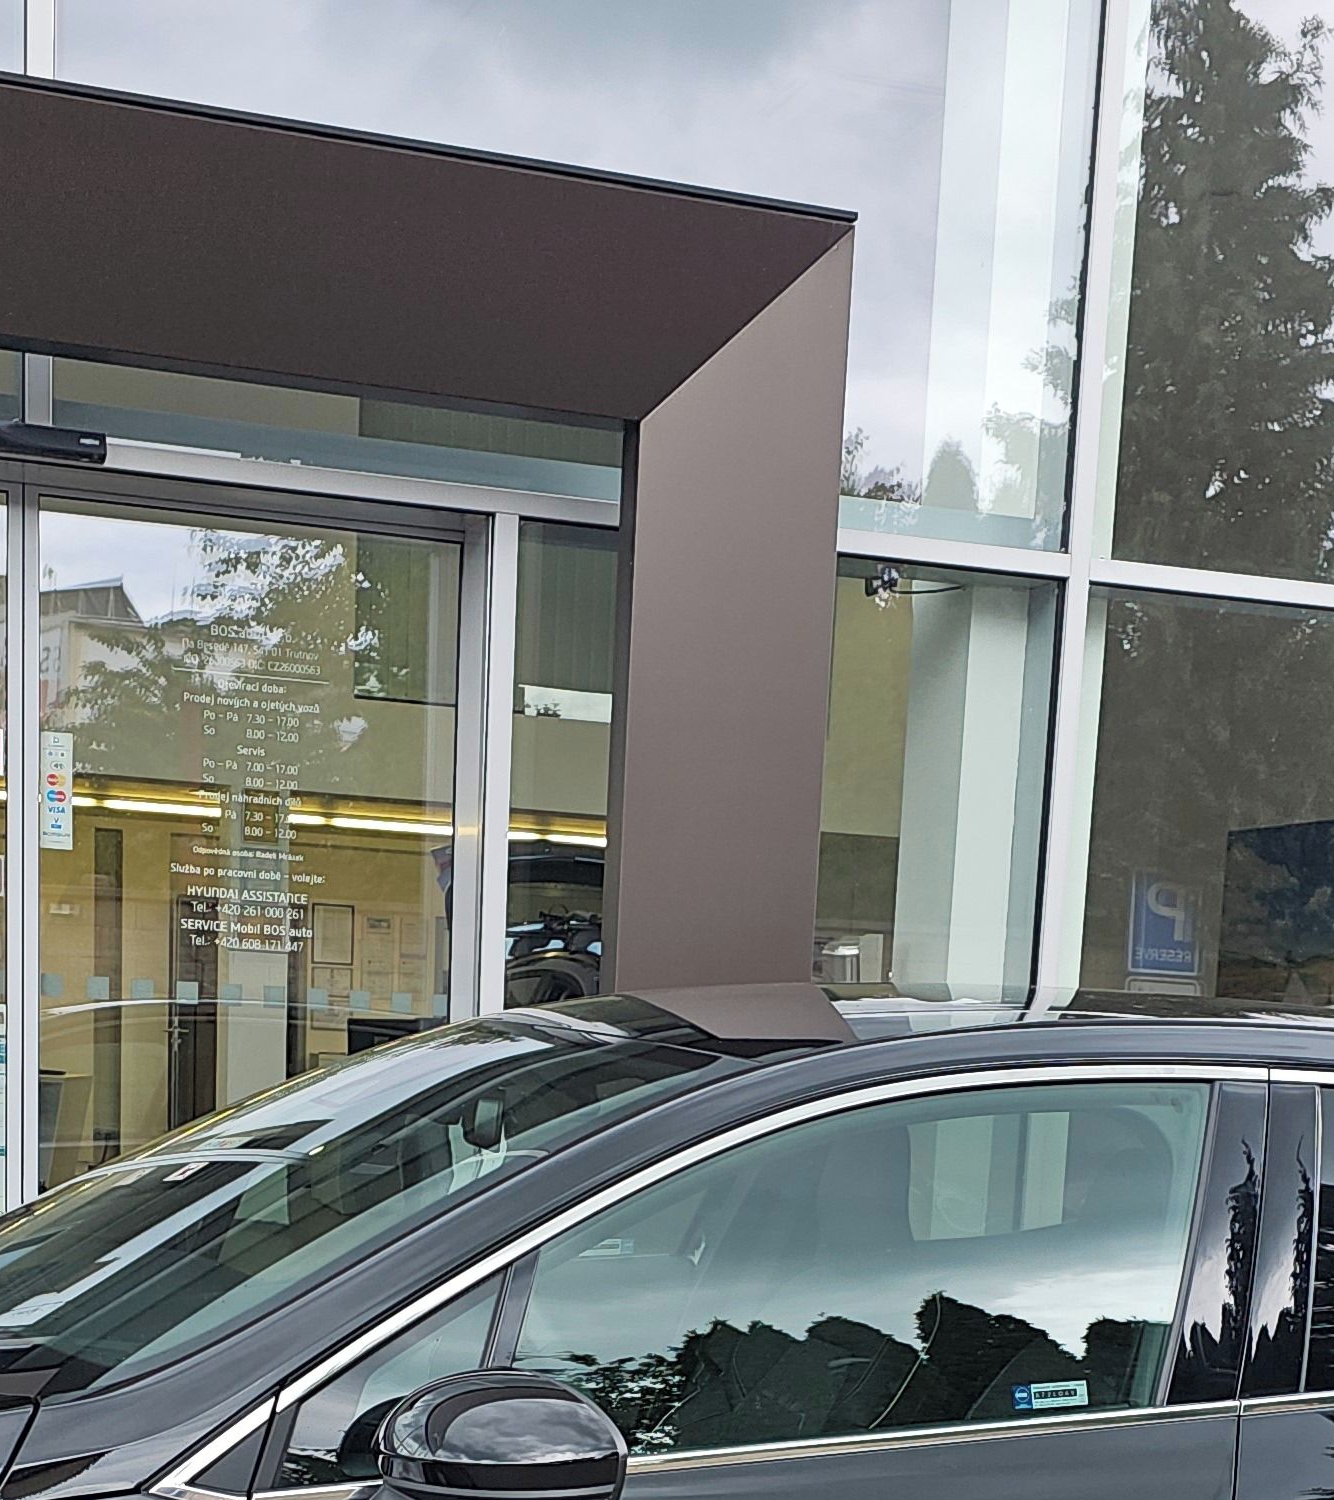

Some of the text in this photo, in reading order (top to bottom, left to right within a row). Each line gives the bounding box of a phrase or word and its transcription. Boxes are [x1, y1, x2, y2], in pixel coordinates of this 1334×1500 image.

[210, 624, 234, 638] BOS
[271, 647, 282, 657] 01
[285, 648, 319, 661] Trutnov
[268, 661, 321, 676] CZ26000563
[262, 683, 287, 694] doba:
[183, 692, 215, 706] Prodej
[217, 694, 251, 709] nových
[203, 709, 216, 721] Po
[226, 712, 239, 723] Pá
[246, 713, 266, 725] 7.30
[276, 716, 300, 728] 17.00
[203, 724, 216, 736] So
[245, 728, 265, 741] 8.00
[276, 730, 299, 743] 12.00
[236, 745, 266, 757] Servis
[202, 757, 215, 769] Po
[246, 761, 265, 773] 7.00
[276, 763, 298, 776] 17.00
[202, 773, 215, 784] So
[245, 776, 265, 788] 8.00
[275, 779, 298, 790] 12.00
[199, 790, 230, 804] Prodej
[244, 811, 264, 822] 7.30
[201, 822, 214, 833] So
[244, 826, 264, 837] 8.00
[274, 828, 297, 840] 12.00
[170, 863, 201, 875] Služba
[203, 867, 215, 878] po
[217, 868, 257, 880] pracovní
[259, 870, 281, 881] době
[292, 874, 326, 886] volejte:
[186, 884, 309, 905] HYUNDAI ASSISTANCE
[215, 904, 241, 916] +420
[243, 906, 261, 917] 261
[264, 907, 284, 919] 000
[286, 908, 304, 920] 261
[180, 918, 313, 938] SERVICE Mobil BOS auto
[214, 937, 240, 949] +420
[242, 938, 261, 950] 608
[264, 939, 281, 950] 171
